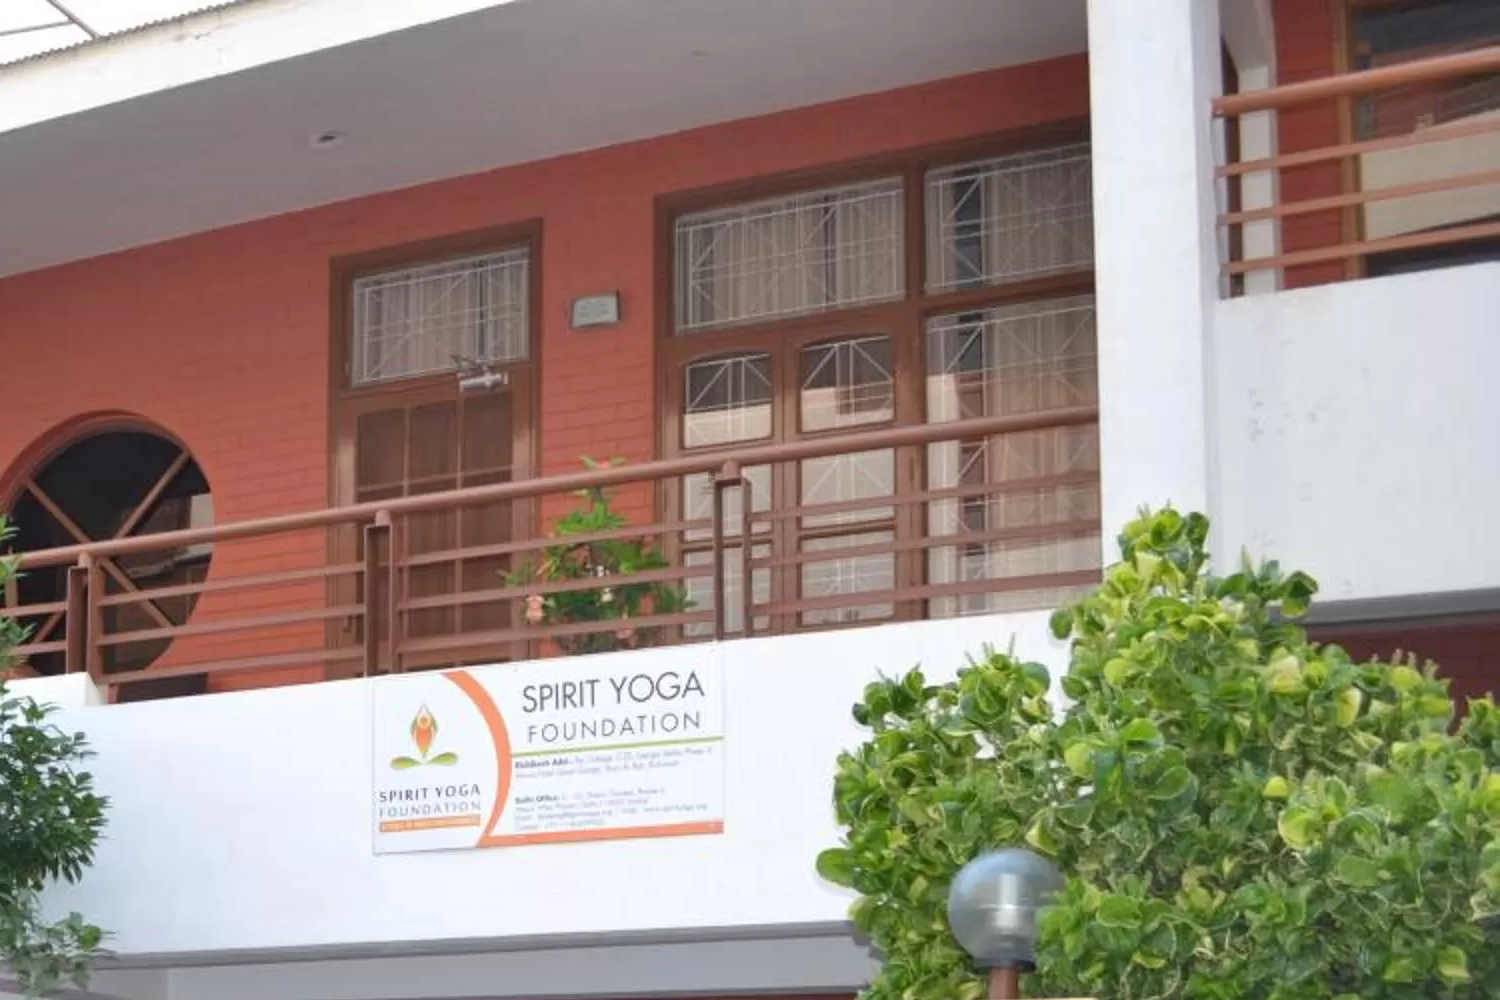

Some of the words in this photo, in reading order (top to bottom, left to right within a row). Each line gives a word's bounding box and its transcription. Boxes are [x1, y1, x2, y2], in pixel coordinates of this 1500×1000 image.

[522, 679, 601, 713] SPIRIT
[609, 670, 705, 704] YOGA
[527, 712, 701, 744] FOUNDATION
[379, 787, 428, 803] SPIRIT
[435, 783, 481, 799] YOGA
[379, 800, 481, 818] FOUNDATION
